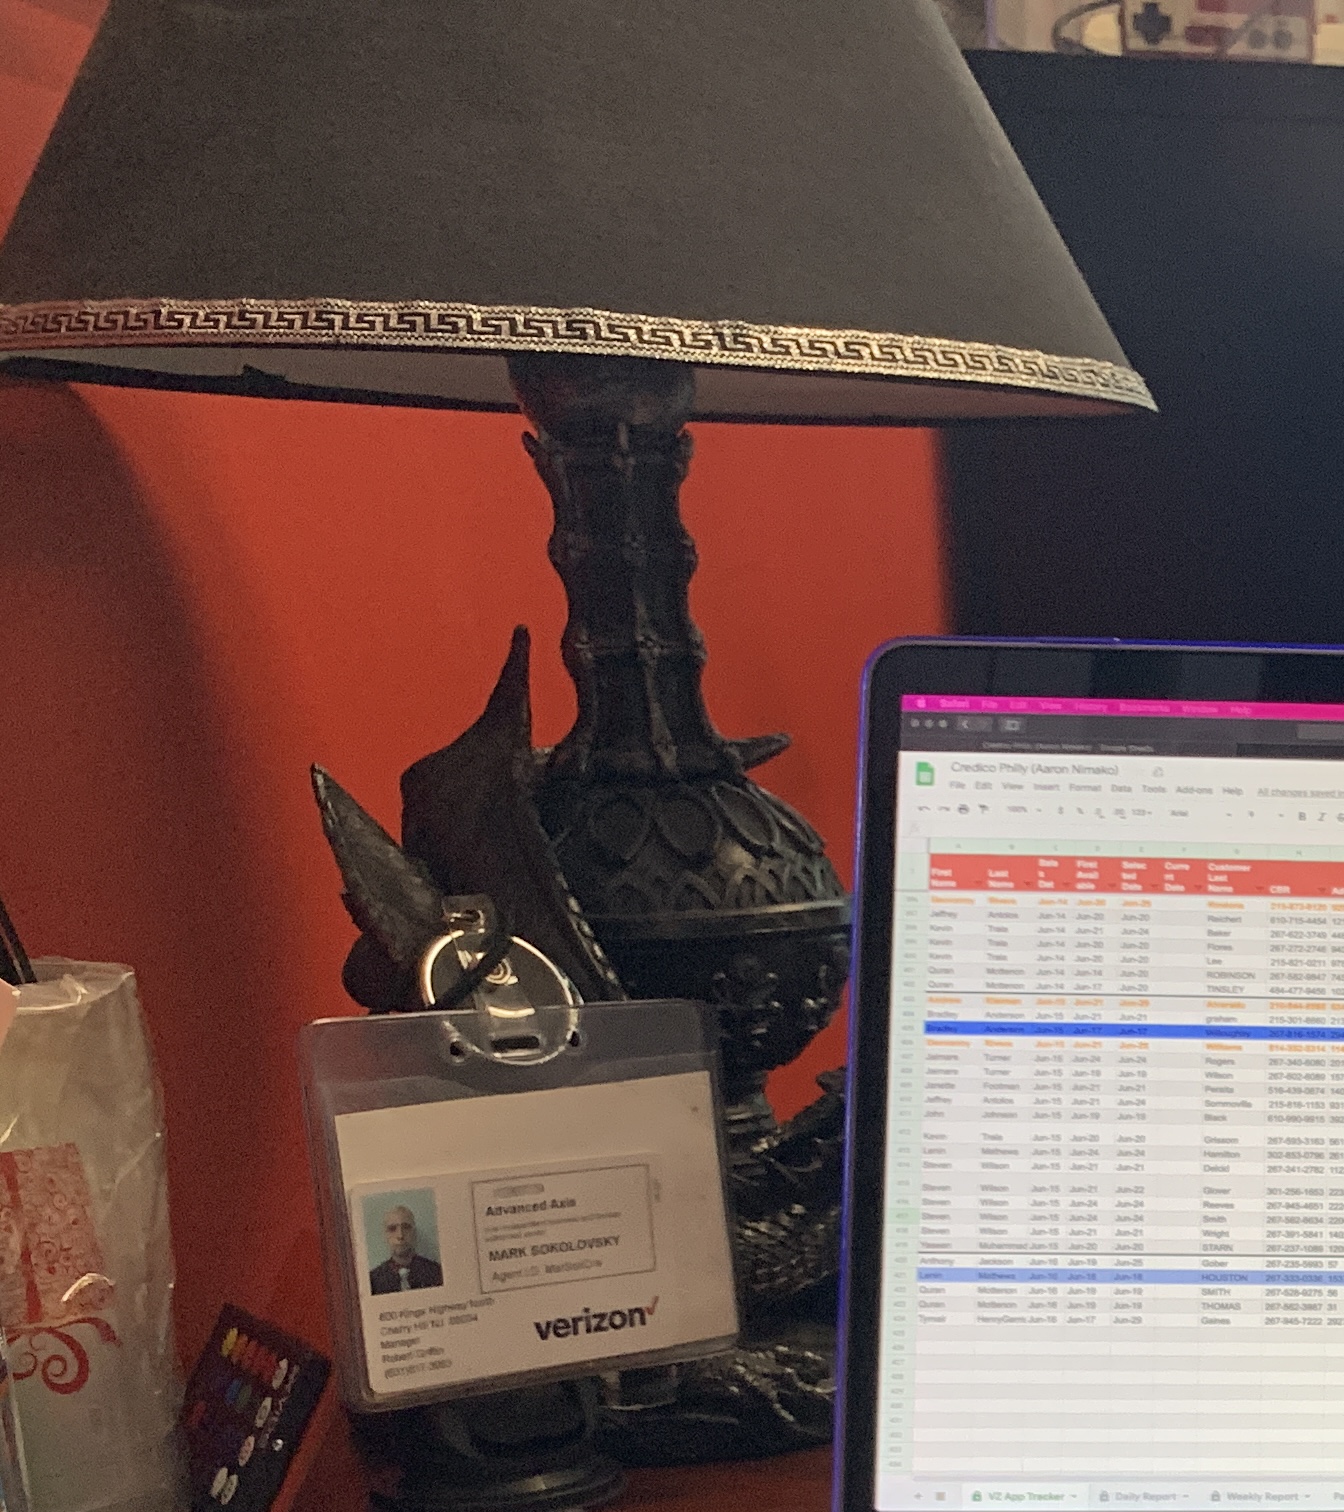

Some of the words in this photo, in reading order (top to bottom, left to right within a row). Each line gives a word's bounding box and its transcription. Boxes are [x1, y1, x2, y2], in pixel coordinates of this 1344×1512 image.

[975, 782, 992, 790] Edit
[1034, 783, 1059, 791] Insert
[1069, 784, 1101, 792] Format
[1111, 785, 1132, 793] Data
[1222, 787, 1243, 796] Help
[489, 1244, 526, 1262] MARK
[534, 1306, 646, 1341] verizon
[1115, 1492, 1137, 1503] Daily
[1140, 1492, 1177, 1503] Report
[1227, 1492, 1261, 1503] Weekly
[1264, 1492, 1299, 1503] Report
